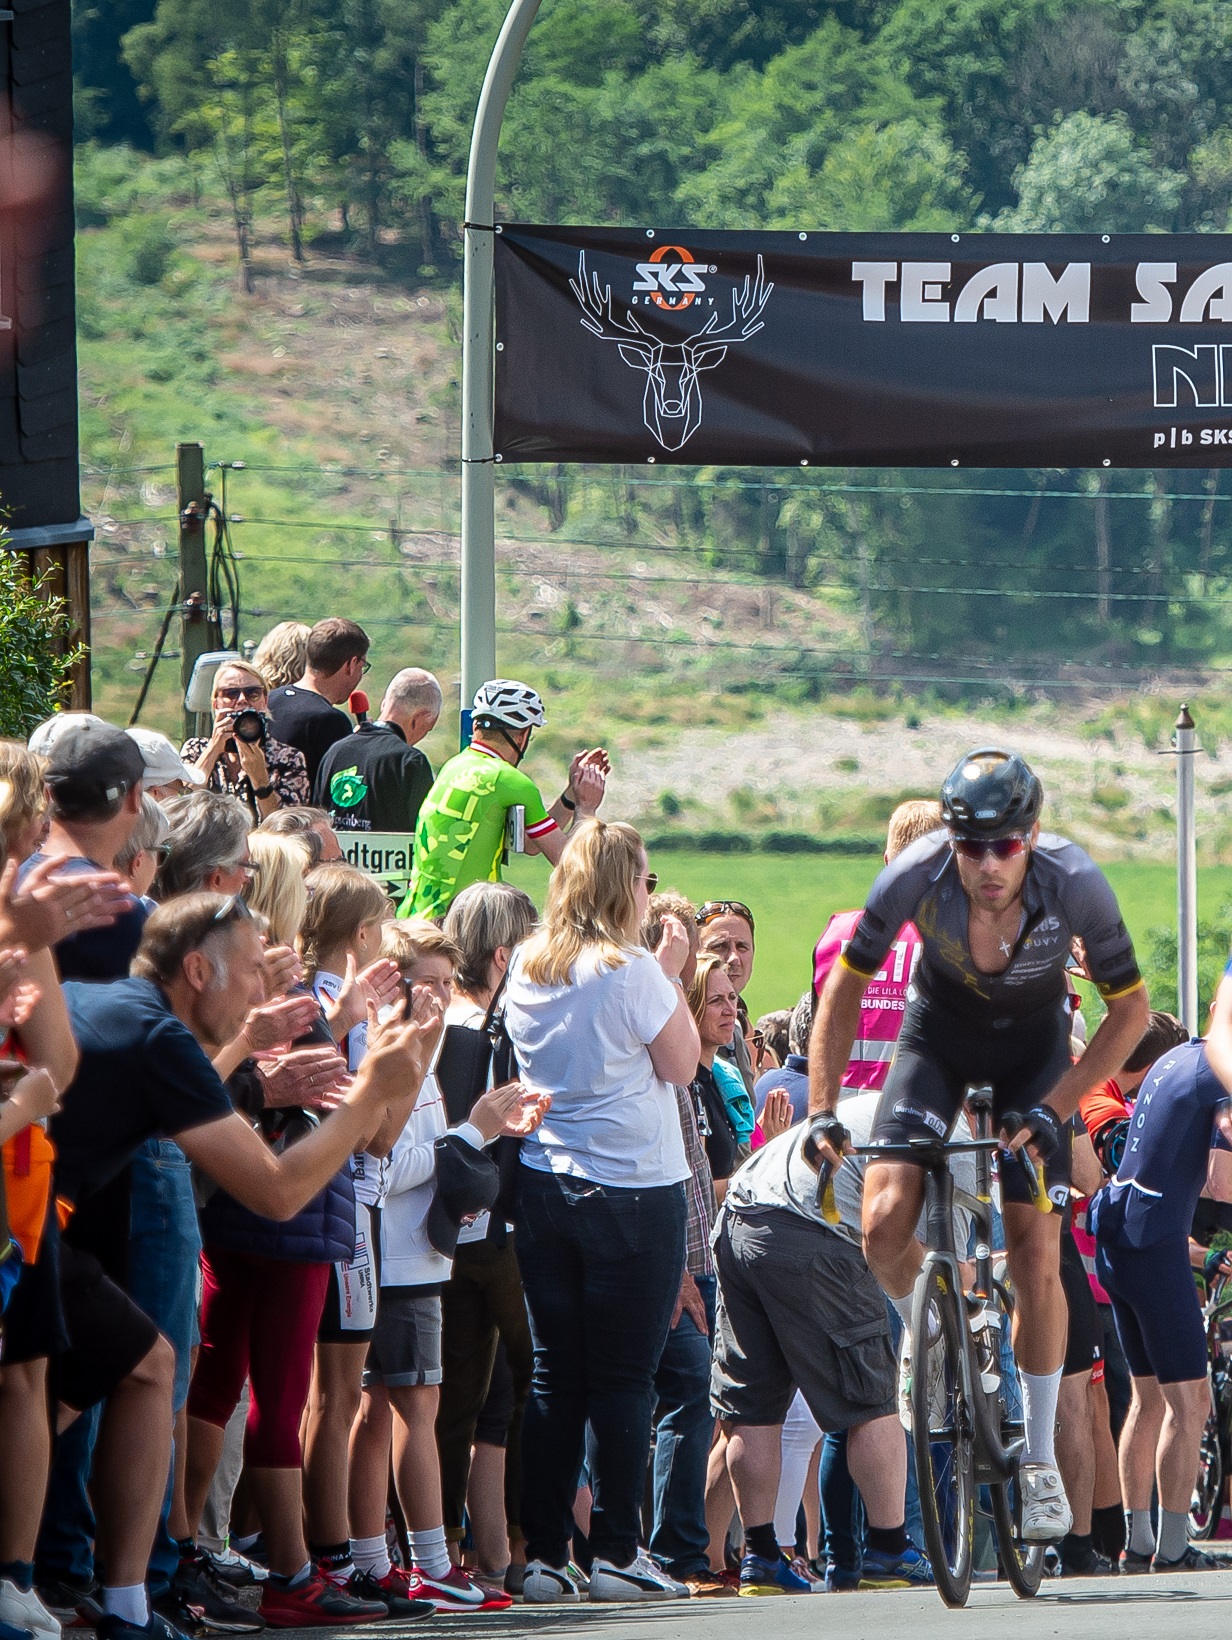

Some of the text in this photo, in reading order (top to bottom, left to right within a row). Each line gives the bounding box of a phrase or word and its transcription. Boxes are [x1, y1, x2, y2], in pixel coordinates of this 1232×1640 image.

[633, 263, 709, 292] SKS
[631, 296, 715, 306] GERMANY
[851, 260, 1092, 325] TEAM
[860, 999, 906, 1011] BUNDES
